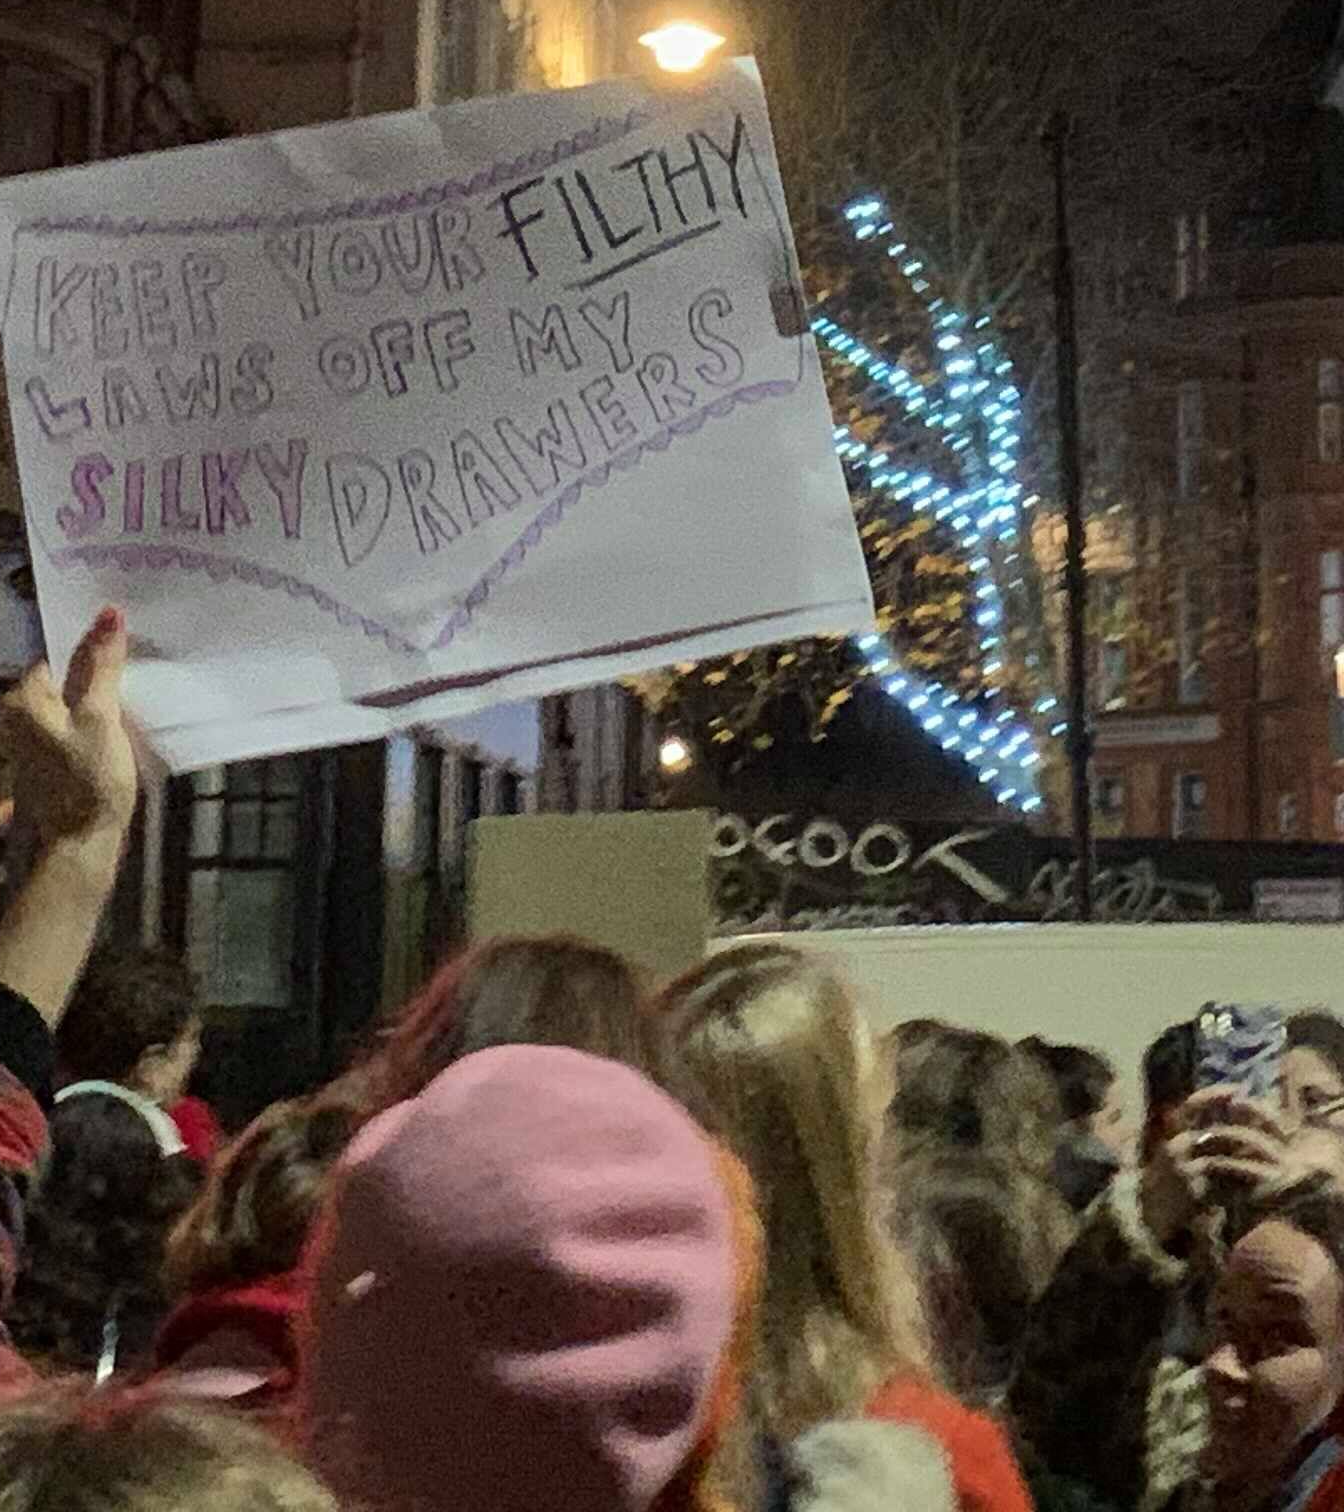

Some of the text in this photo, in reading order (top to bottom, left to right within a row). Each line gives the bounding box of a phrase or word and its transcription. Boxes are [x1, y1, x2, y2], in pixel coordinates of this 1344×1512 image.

[32, 114, 753, 362] KEEP YOUR FILTHY
[24, 294, 636, 441] LAWS OFF MY
[56, 290, 751, 568] SILKY DRAWERS
